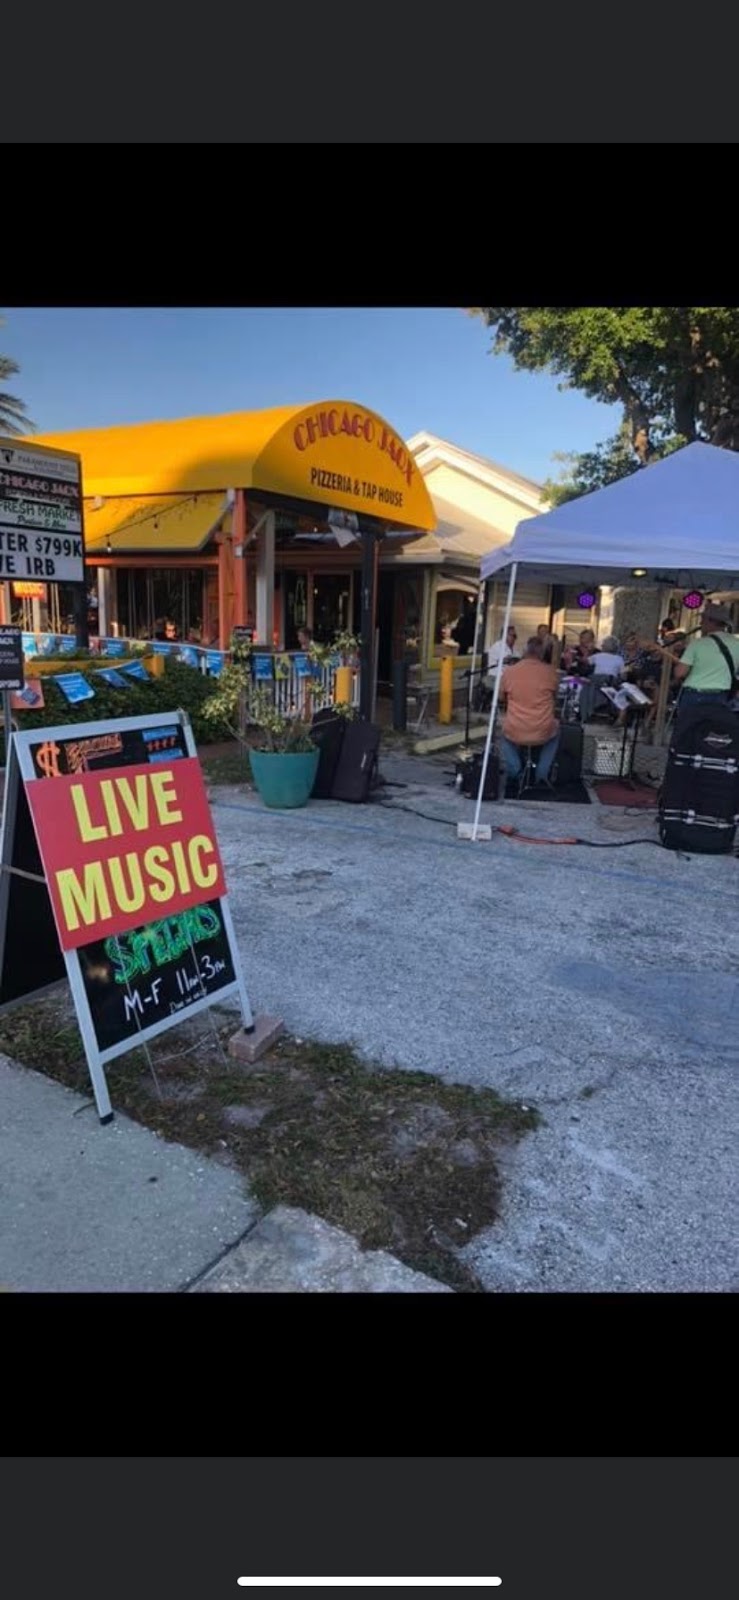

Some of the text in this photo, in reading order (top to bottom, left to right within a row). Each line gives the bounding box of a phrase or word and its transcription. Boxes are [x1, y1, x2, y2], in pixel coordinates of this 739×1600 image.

[293, 408, 414, 487] CHICAGO JACK
[310, 467, 404, 508] PIZZERIA & TAP HOUSE
[26, 556, 55, 576] IRB
[35, 536, 82, 557] $799K
[70, 770, 183, 844] LIVE
[55, 834, 219, 932] MUSIC
[122, 977, 162, 1022] M-F
